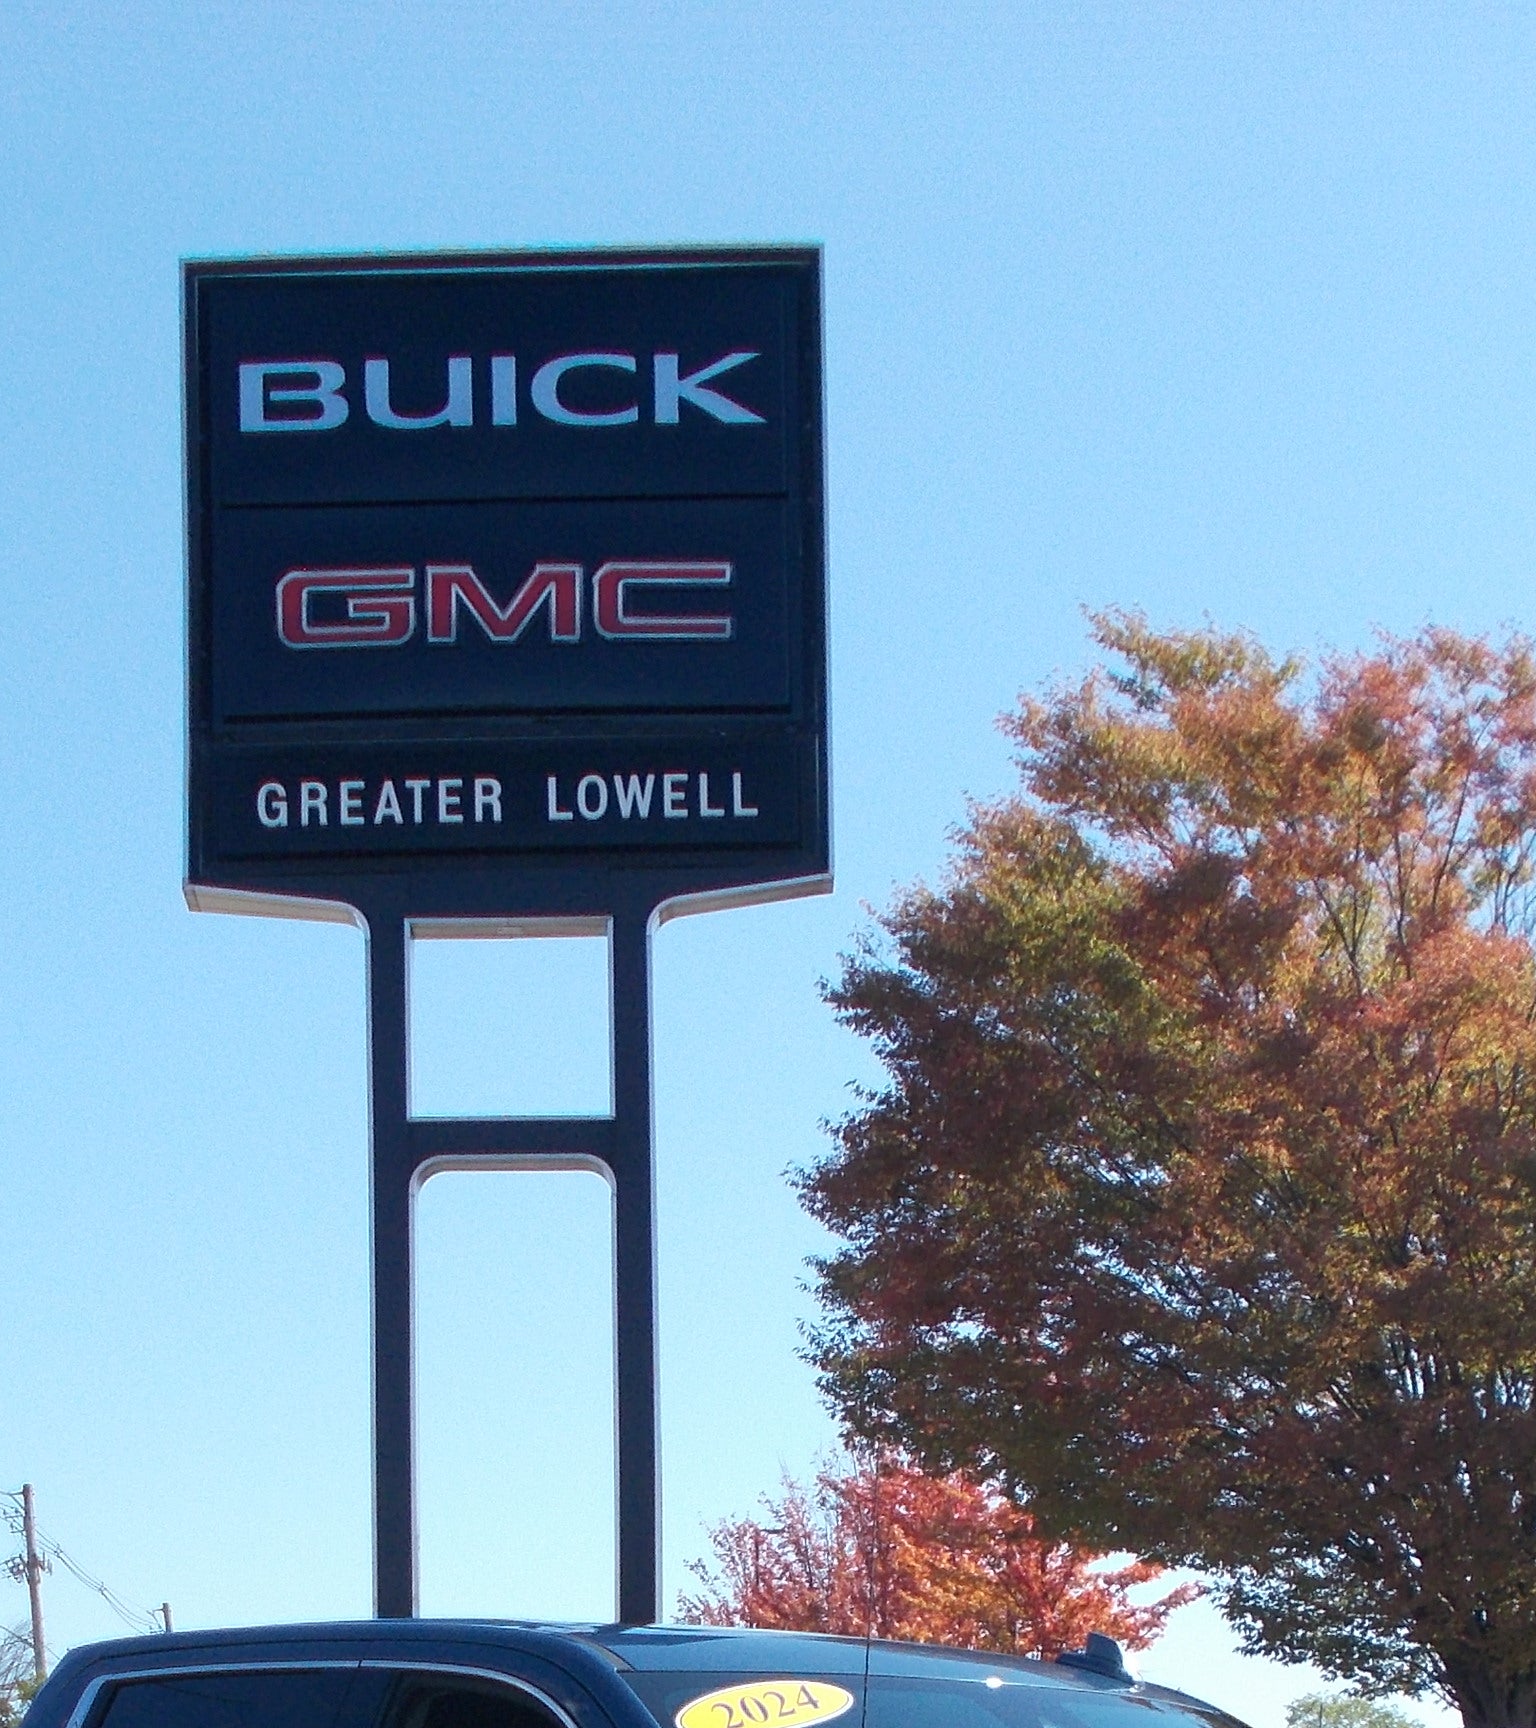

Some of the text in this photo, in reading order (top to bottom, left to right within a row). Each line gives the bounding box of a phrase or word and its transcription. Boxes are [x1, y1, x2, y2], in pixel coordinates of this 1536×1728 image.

[238, 352, 767, 434] BUICK
[276, 561, 733, 650] GMC
[256, 771, 759, 828] GREATER LOWELL
